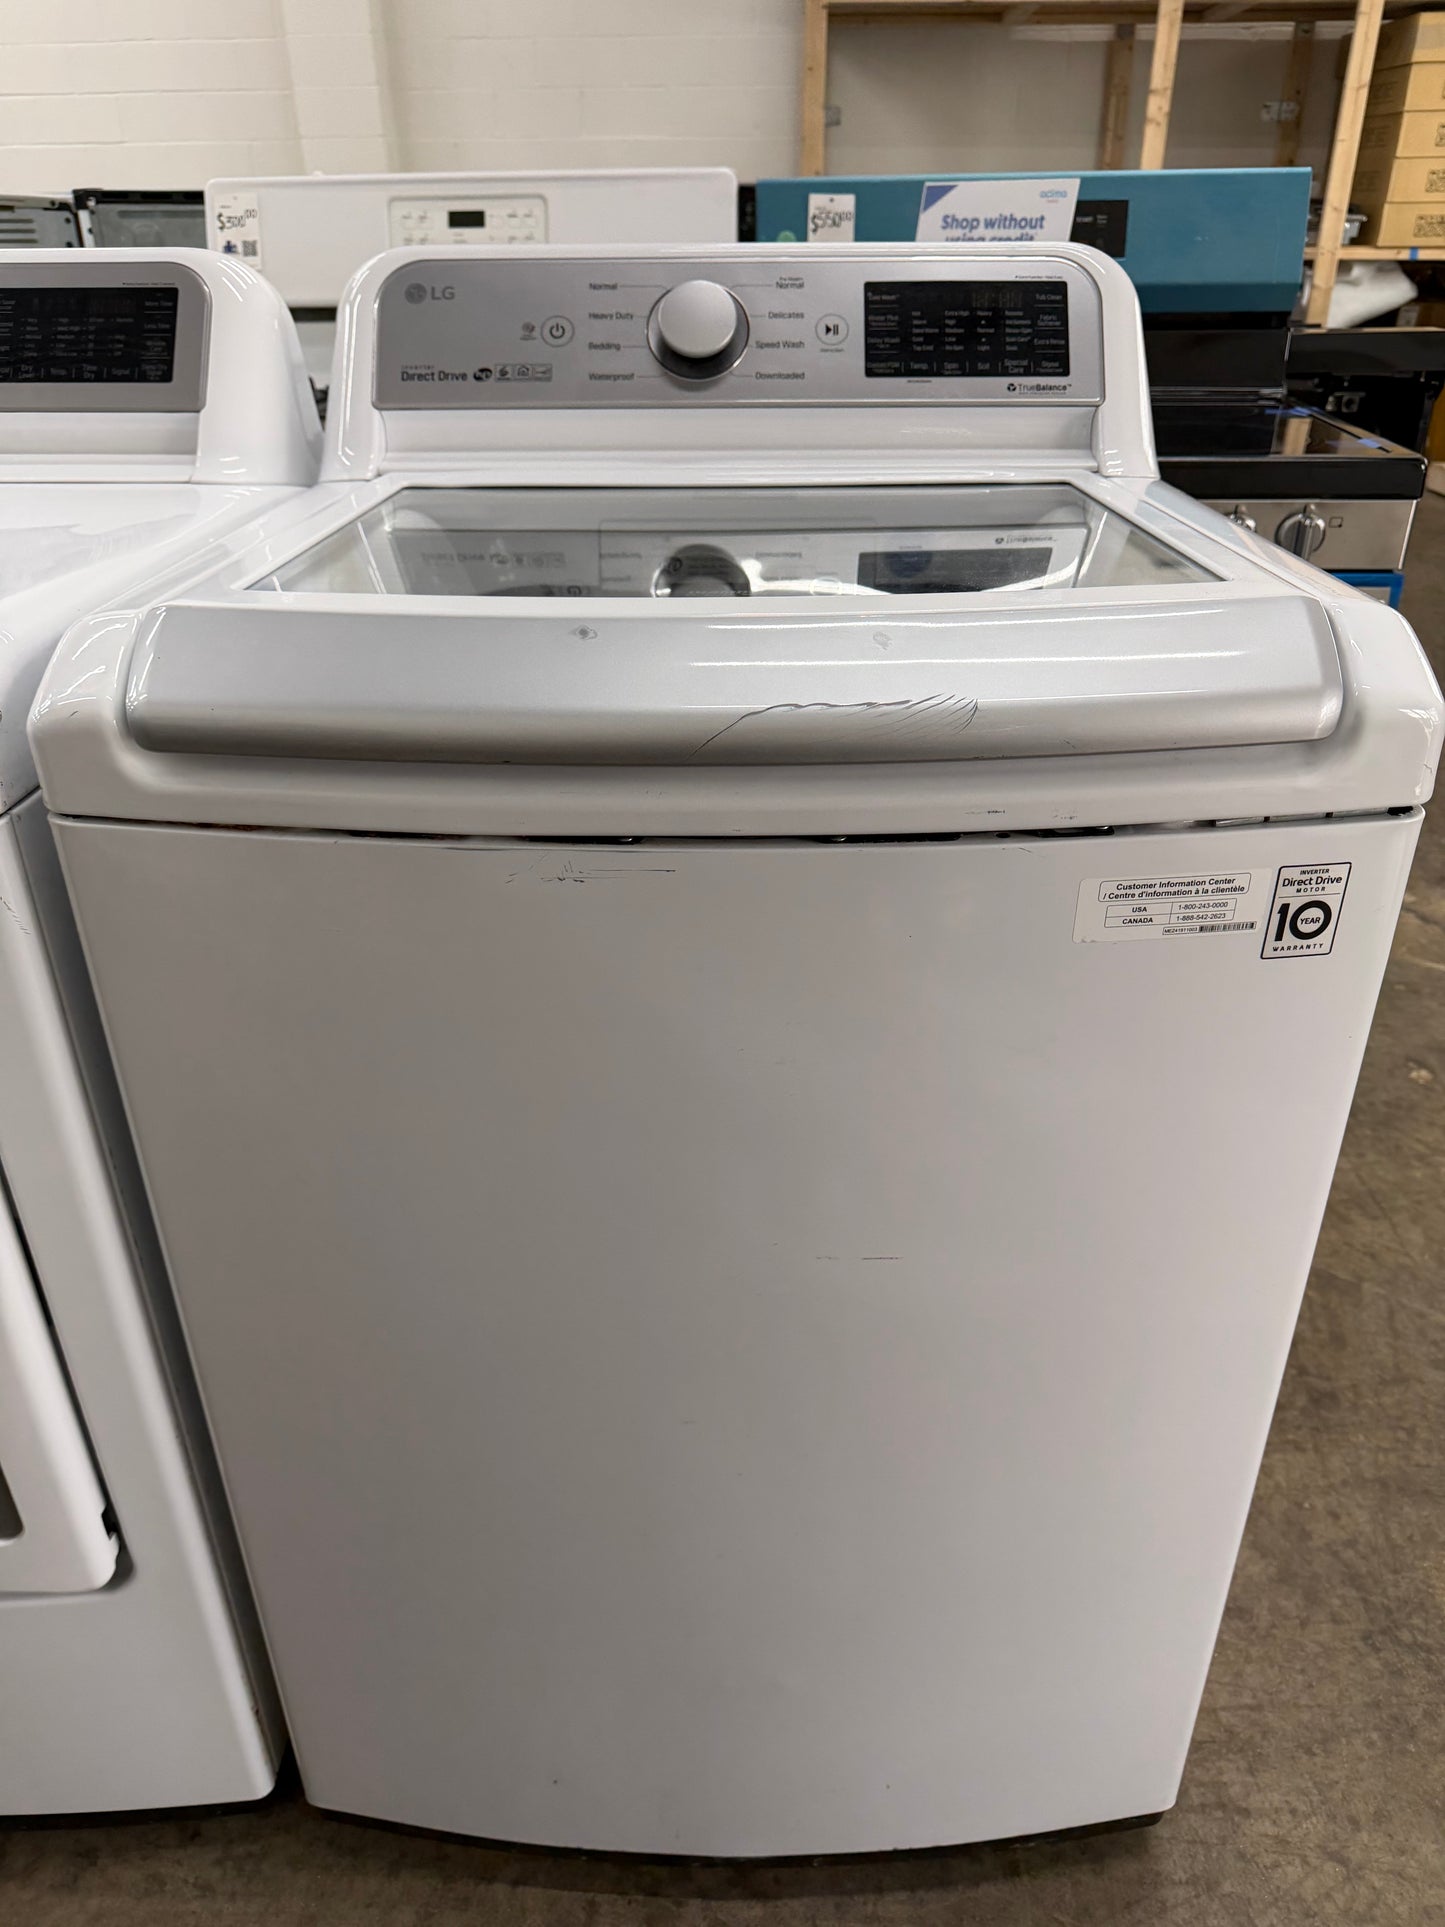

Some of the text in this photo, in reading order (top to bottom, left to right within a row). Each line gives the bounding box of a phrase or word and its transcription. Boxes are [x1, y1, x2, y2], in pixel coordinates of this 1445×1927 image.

[941, 213, 1045, 232] Shop without
[776, 281, 805, 289] Normal
[431, 286, 455, 301] LG
[588, 312, 633, 320] Heavy Duty
[588, 342, 621, 351] Bedding
[755, 341, 780, 349] Speed
[401, 371, 435, 382] Direct
[438, 371, 468, 382] Drive
[588, 373, 635, 381] Waterproof
[755, 372, 805, 380] Downloaded
[1300, 868, 1330, 876] INVERTER
[1116, 877, 1236, 891] Customer Information Center
[1282, 875, 1342, 887] Direct Drive
[1108, 891, 1136, 900] Centre
[1138, 888, 1192, 899] d'information
[1194, 887, 1200, 895] à
[1201, 887, 1209, 895] la
[1210, 884, 1245, 894] clientèle
[1178, 901, 1229, 911] 1-800-243-0000
[1122, 912, 1227, 925] CANADA 1-888-542-2623
[1274, 900, 1332, 941] 10
[1300, 916, 1321, 925] YEAR
[1272, 943, 1324, 952] WARRANTY
